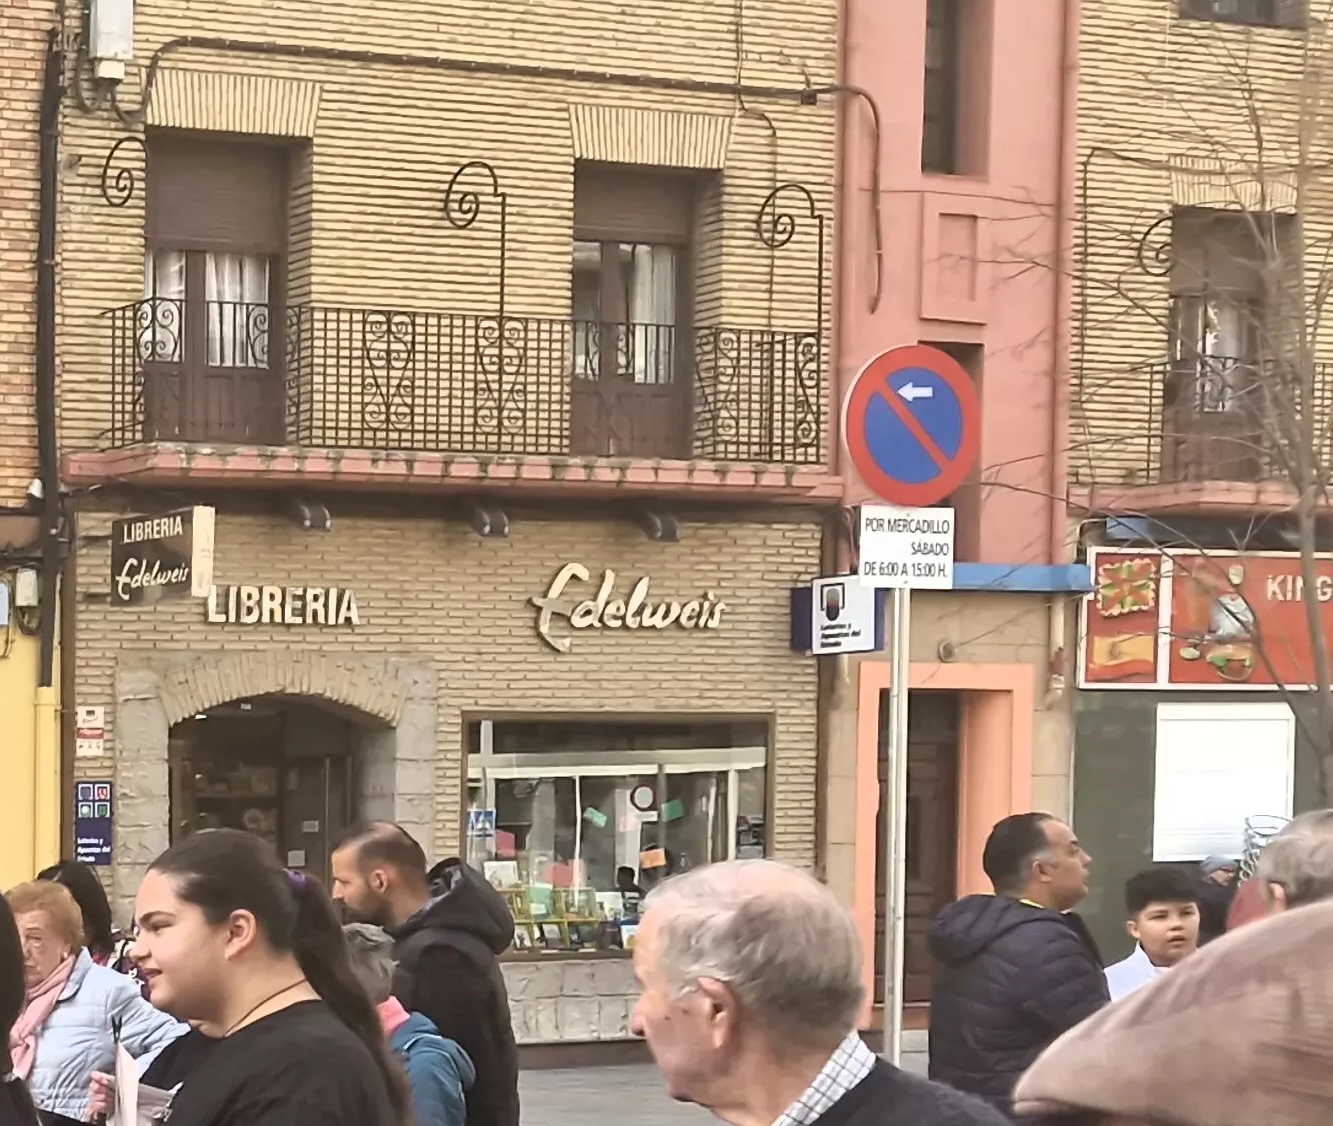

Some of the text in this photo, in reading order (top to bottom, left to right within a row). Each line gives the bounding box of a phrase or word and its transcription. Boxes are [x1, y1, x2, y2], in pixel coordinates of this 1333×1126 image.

[123, 516, 183, 544] LIBRERIA
[865, 518, 950, 534] POR MERCADILLO
[115, 558, 189, 600] Edelweis
[864, 562, 876, 576] DE
[879, 562, 899, 576] 6:00
[901, 563, 908, 576] A
[912, 562, 936, 577] 15:00
[207, 584, 361, 625] LIBRERIA
[527, 562, 728, 652] Edelweis
